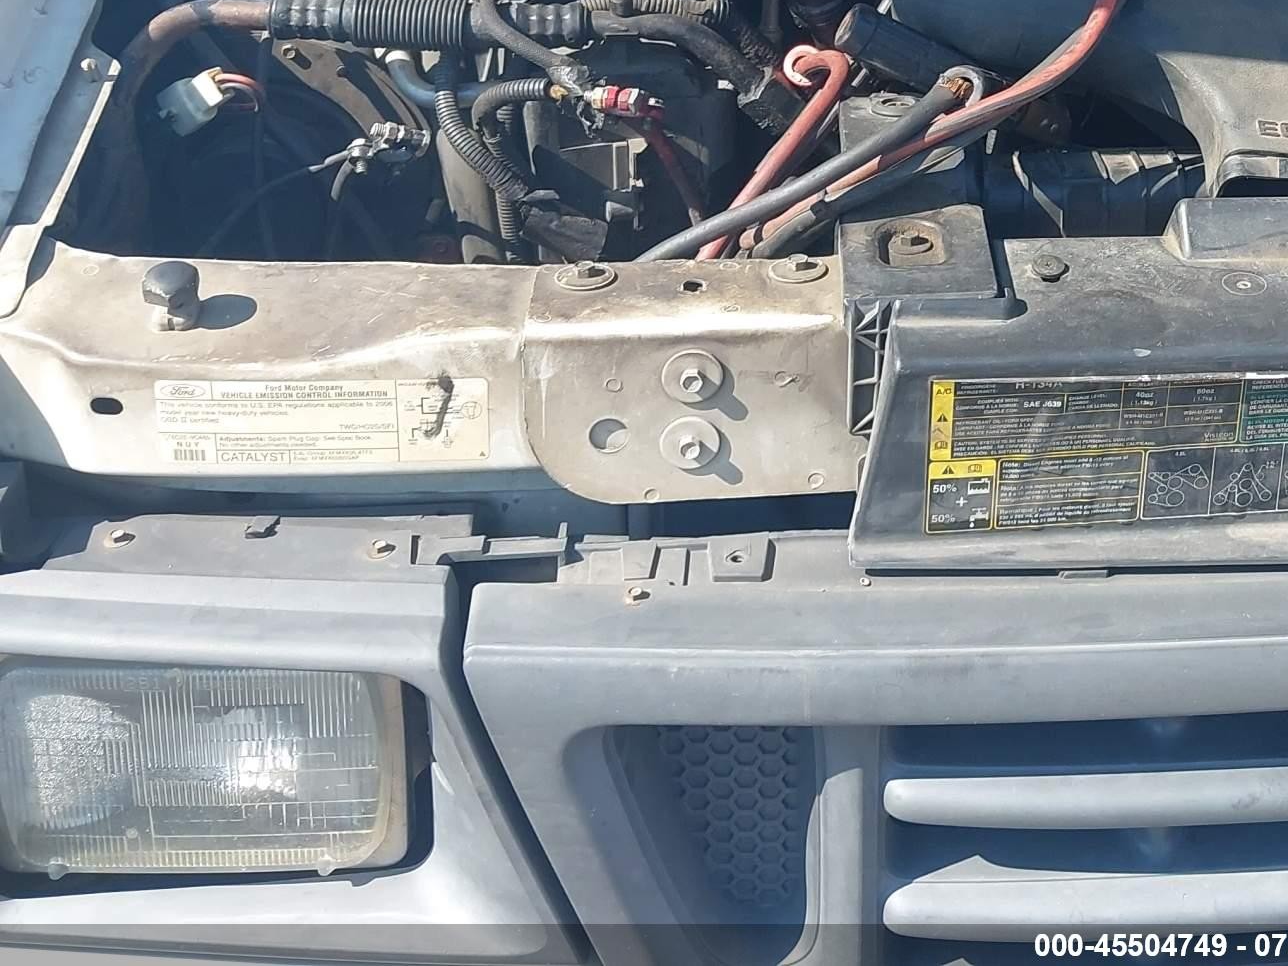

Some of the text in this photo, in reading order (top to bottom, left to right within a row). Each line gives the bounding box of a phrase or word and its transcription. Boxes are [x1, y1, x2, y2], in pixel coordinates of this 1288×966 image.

[170, 386, 196, 395] Ford
[221, 452, 285, 462] CATALYST
[932, 483, 957, 493] 50%
[931, 514, 956, 523] 50%
